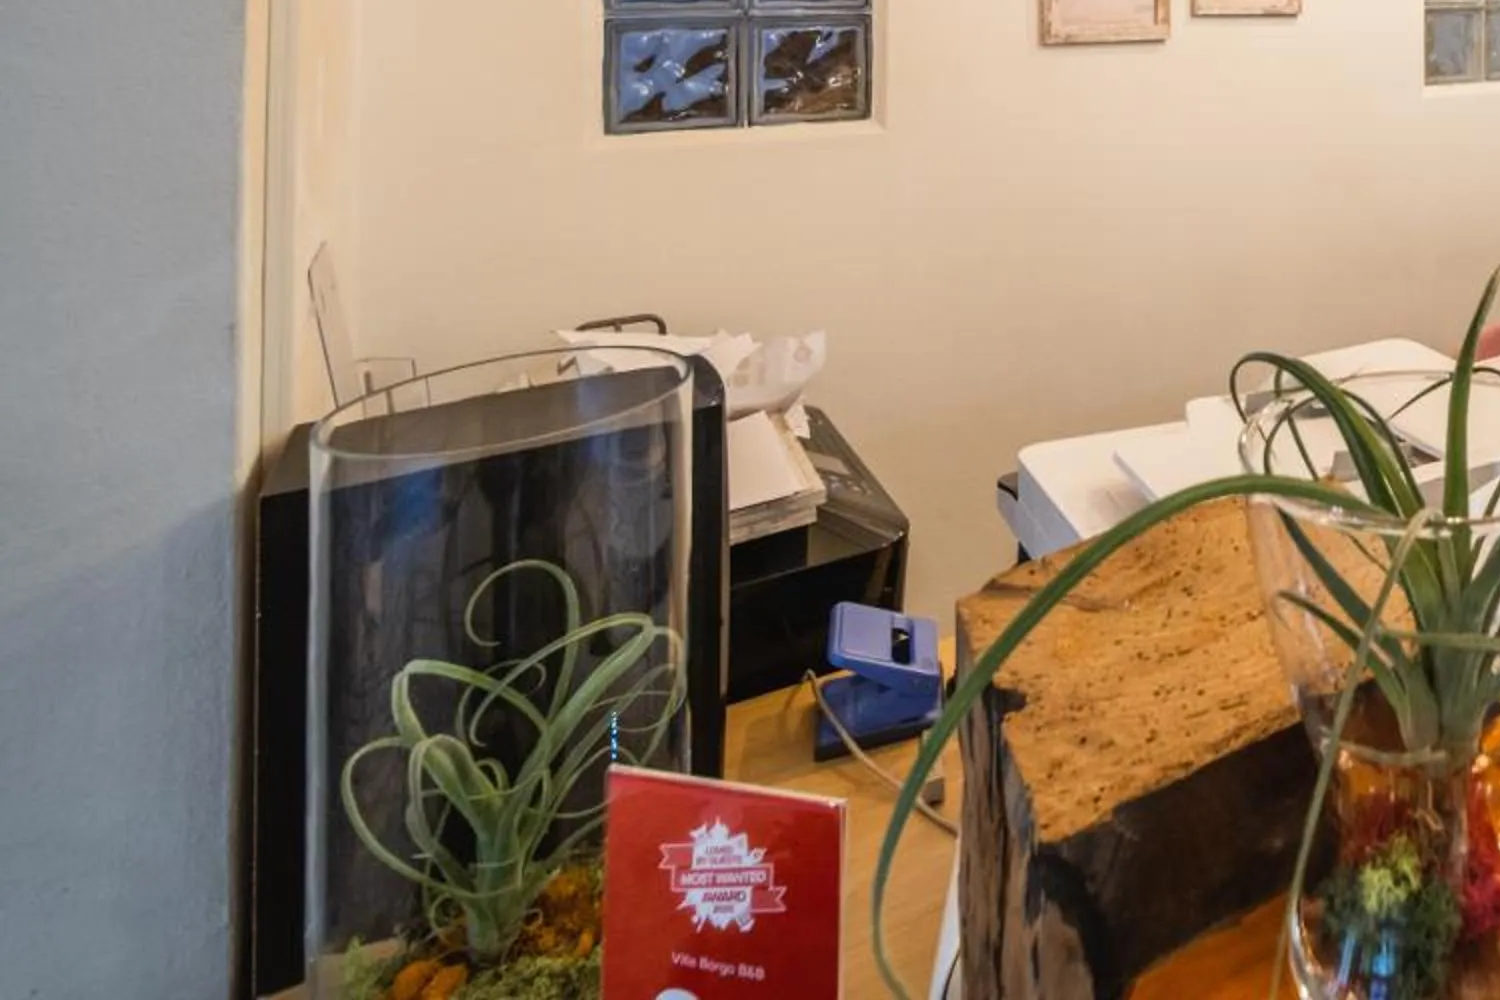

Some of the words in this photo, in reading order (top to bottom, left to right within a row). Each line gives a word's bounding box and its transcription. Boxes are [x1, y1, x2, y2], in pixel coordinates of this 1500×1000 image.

[681, 872, 713, 886] MOST
[715, 870, 767, 884] WANTED
[702, 890, 747, 902] AWARD
